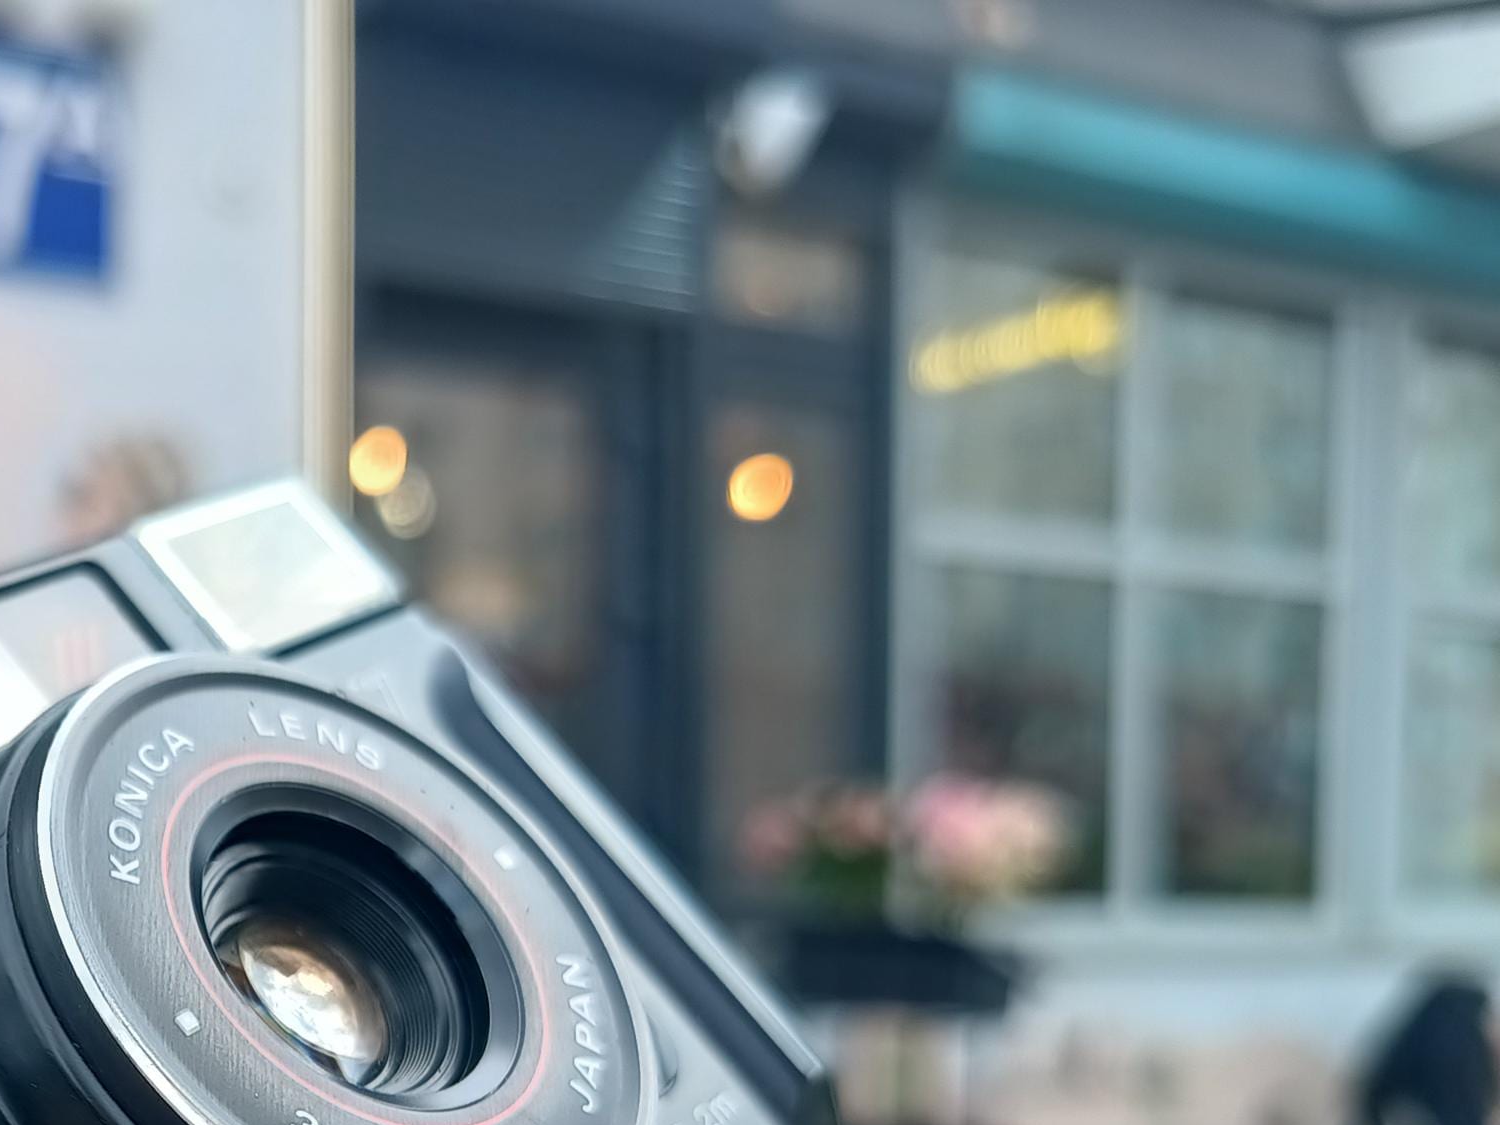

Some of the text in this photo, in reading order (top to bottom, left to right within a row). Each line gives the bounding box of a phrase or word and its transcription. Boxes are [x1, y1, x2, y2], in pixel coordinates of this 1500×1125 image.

[107, 707, 384, 886] KONICA LENS
[555, 952, 607, 1114] JAPAN
